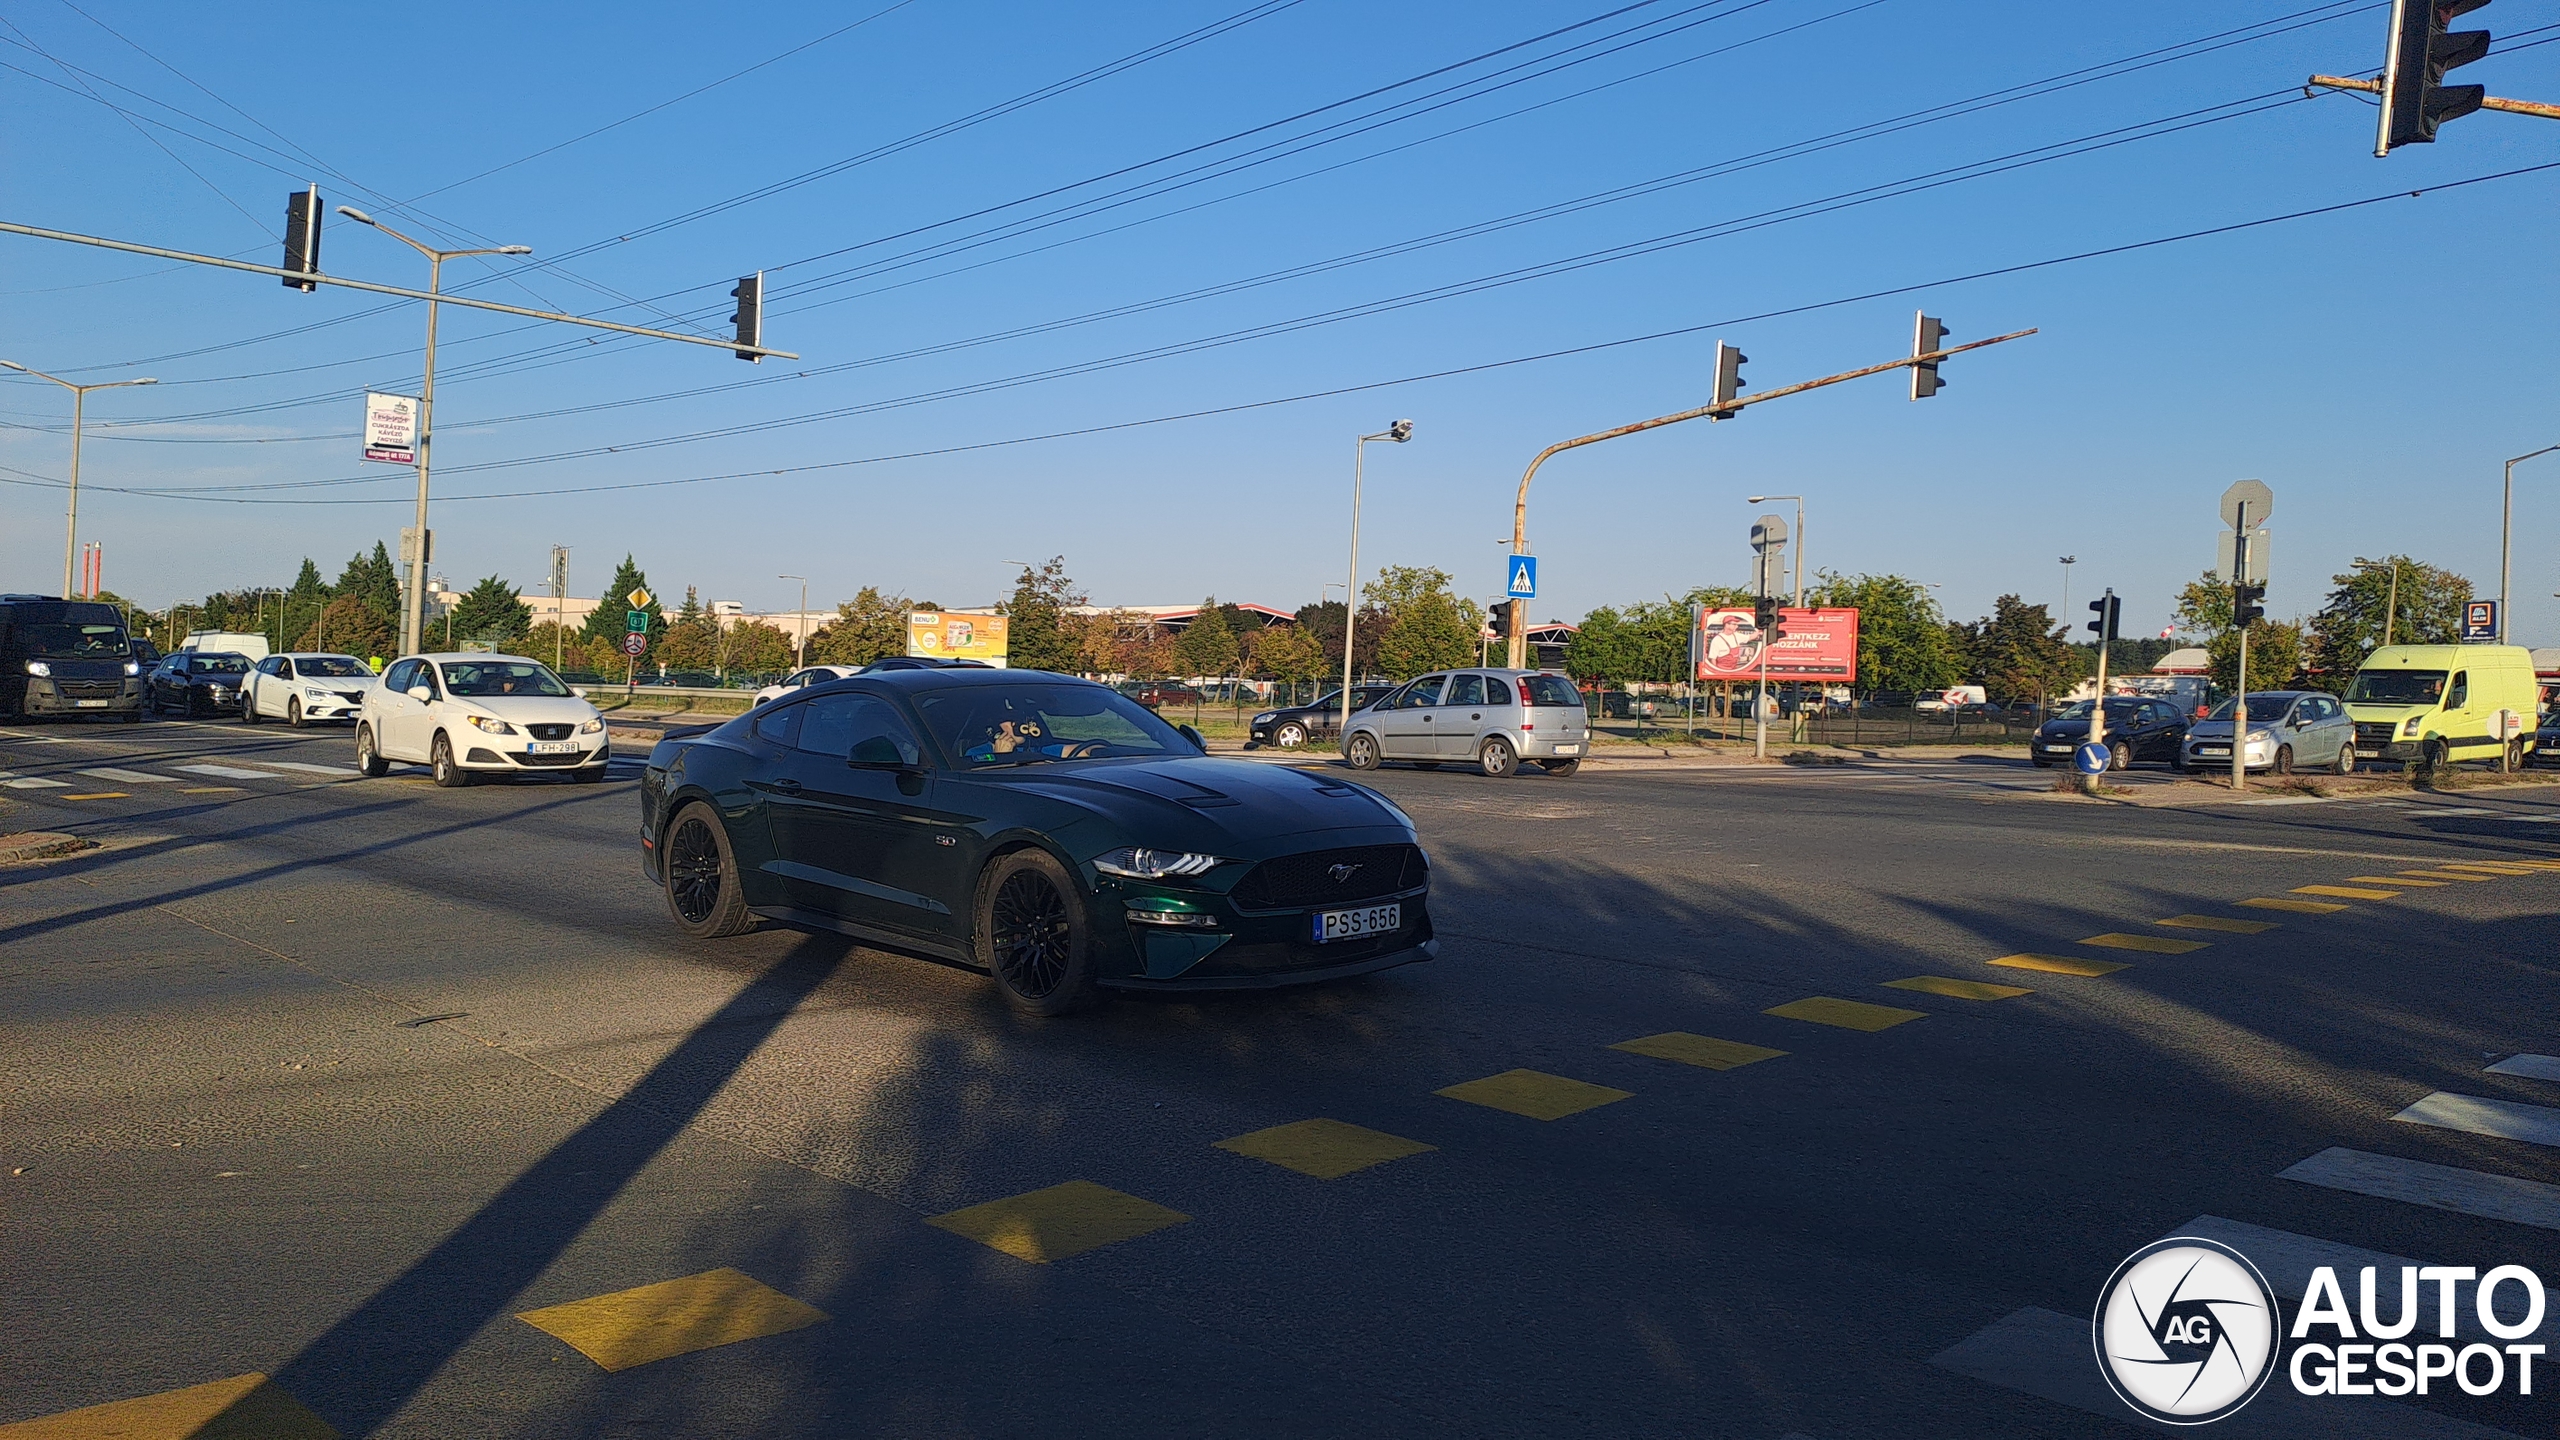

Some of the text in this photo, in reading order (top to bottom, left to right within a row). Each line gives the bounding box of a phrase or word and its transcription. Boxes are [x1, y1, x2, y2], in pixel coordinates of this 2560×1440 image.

[372, 422, 410, 431] CUKRÁSZDA
[2138, 687, 2178, 696] Logistics
[535, 744, 576, 752] LFH-298
[1326, 907, 1397, 937] PSS-656
